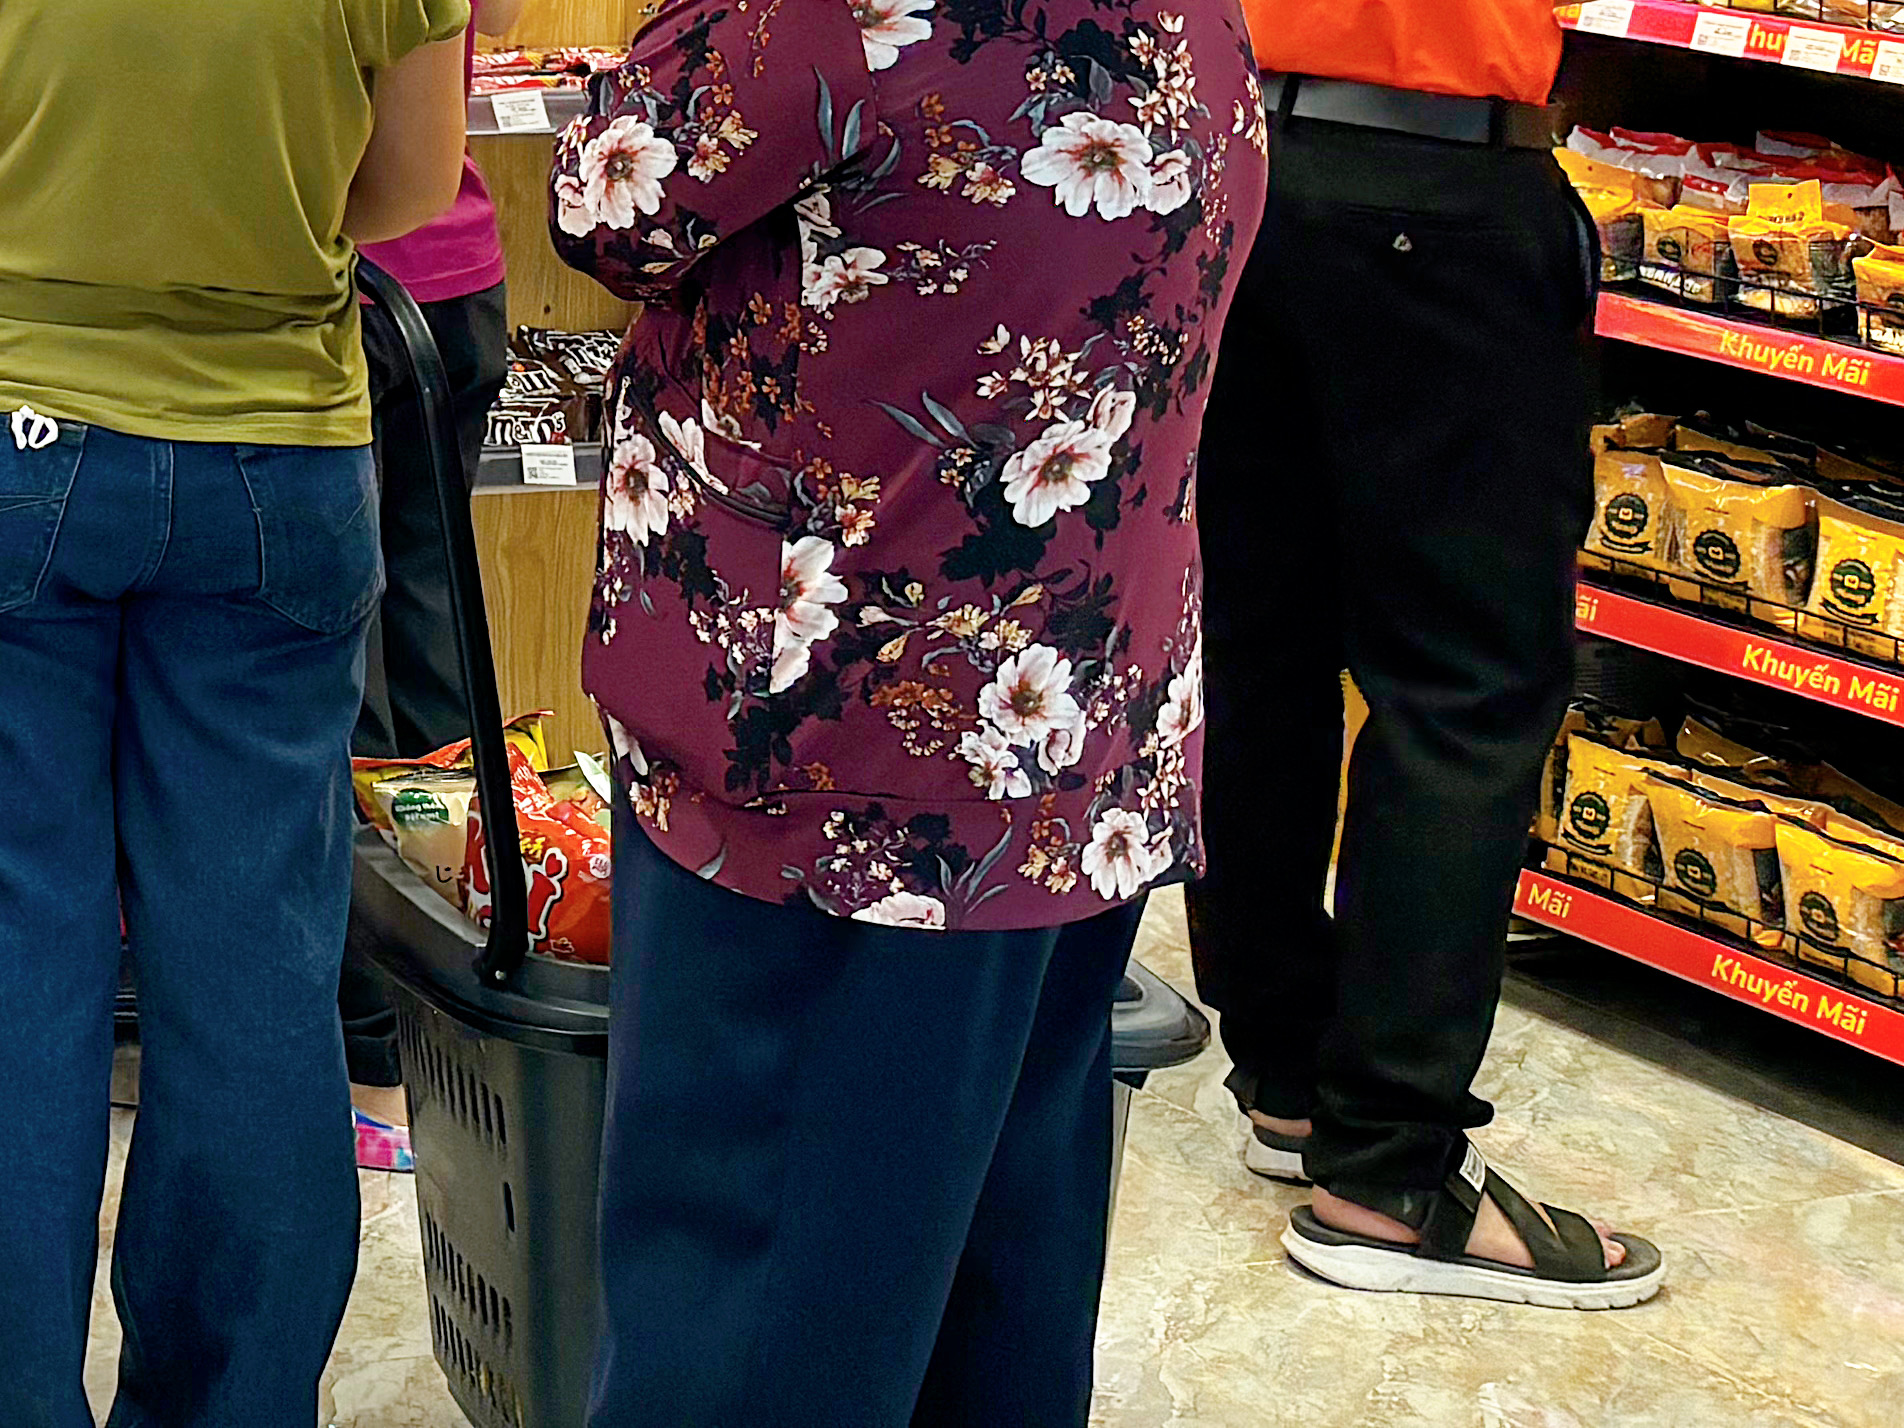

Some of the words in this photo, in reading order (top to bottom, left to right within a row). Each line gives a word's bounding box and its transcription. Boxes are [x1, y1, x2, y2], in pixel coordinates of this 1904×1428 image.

[1720, 330, 1814, 374] Khuyến
[1822, 354, 1871, 386] Mãi
[1741, 644, 1843, 697] Khuyến
[1848, 672, 1900, 713] Mãi
[1527, 883, 1571, 919] Mãi
[1710, 953, 1811, 1017] Khuyến
[1816, 992, 1868, 1036] Mãi
